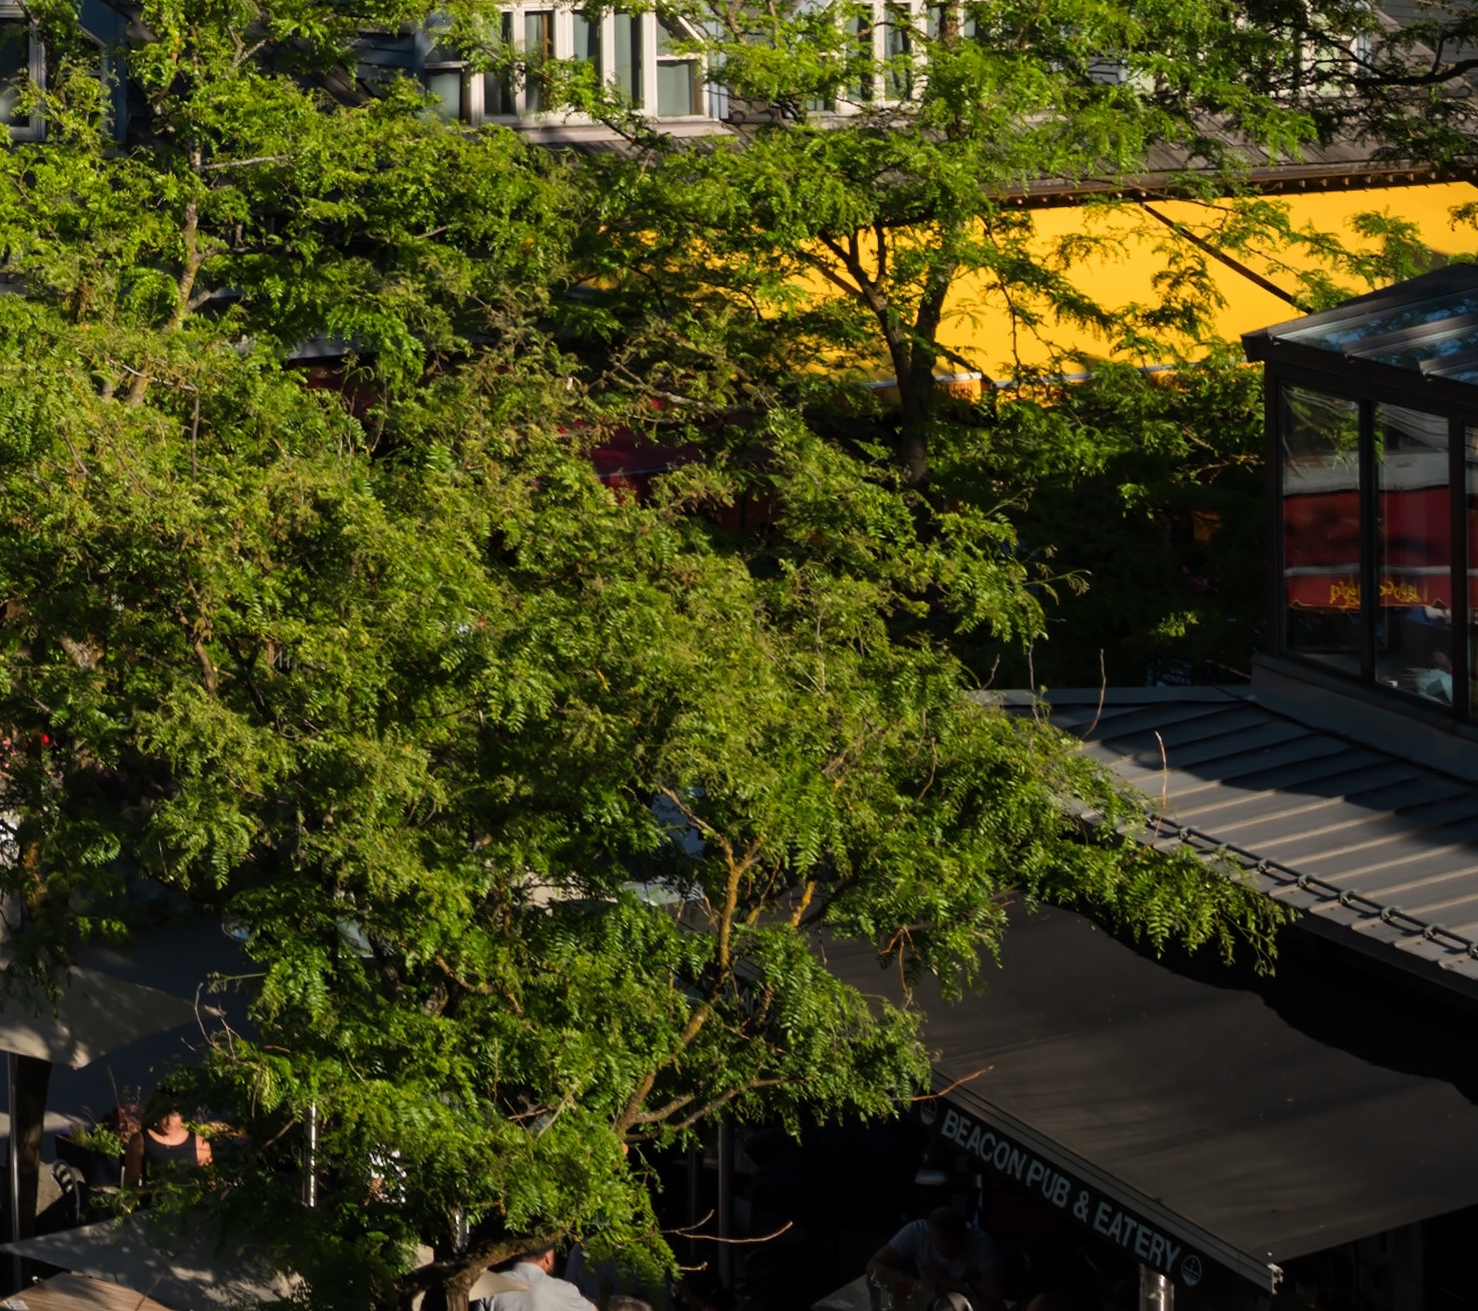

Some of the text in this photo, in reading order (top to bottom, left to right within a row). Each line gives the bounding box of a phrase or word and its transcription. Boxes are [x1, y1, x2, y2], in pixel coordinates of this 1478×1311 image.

[940, 1109, 1181, 1273] BEACON PUB & EATERY
